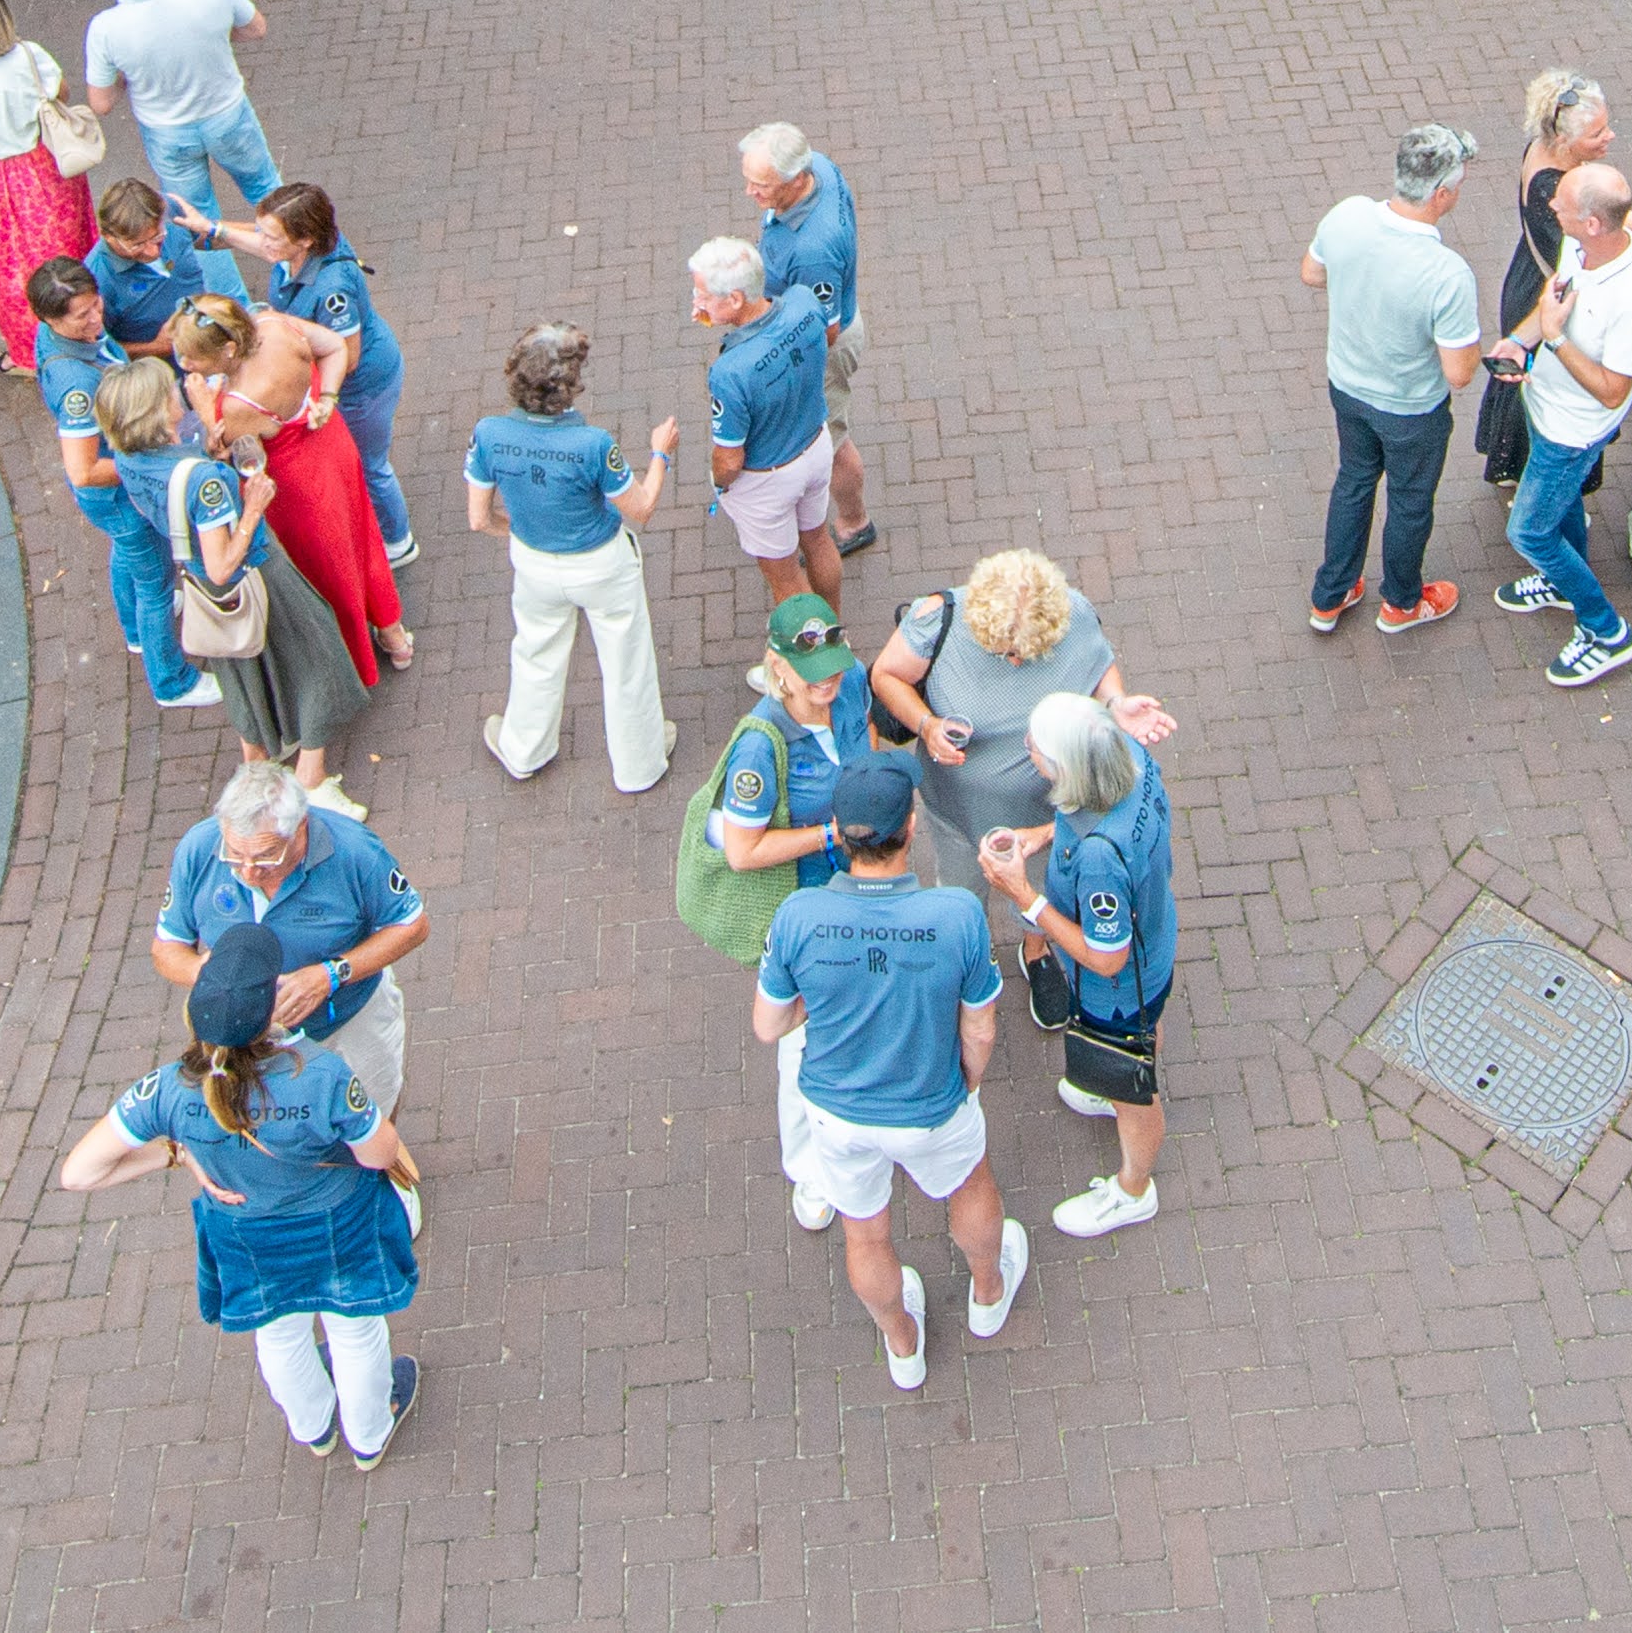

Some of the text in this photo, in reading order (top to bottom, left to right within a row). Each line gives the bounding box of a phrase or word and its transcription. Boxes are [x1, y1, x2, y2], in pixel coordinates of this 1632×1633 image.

[754, 310, 816, 372] CITO MOTORS
[492, 443, 585, 464] CITO MOTORS
[1131, 807, 1148, 843] CITO
[814, 924, 937, 943] CITO MOTORS
